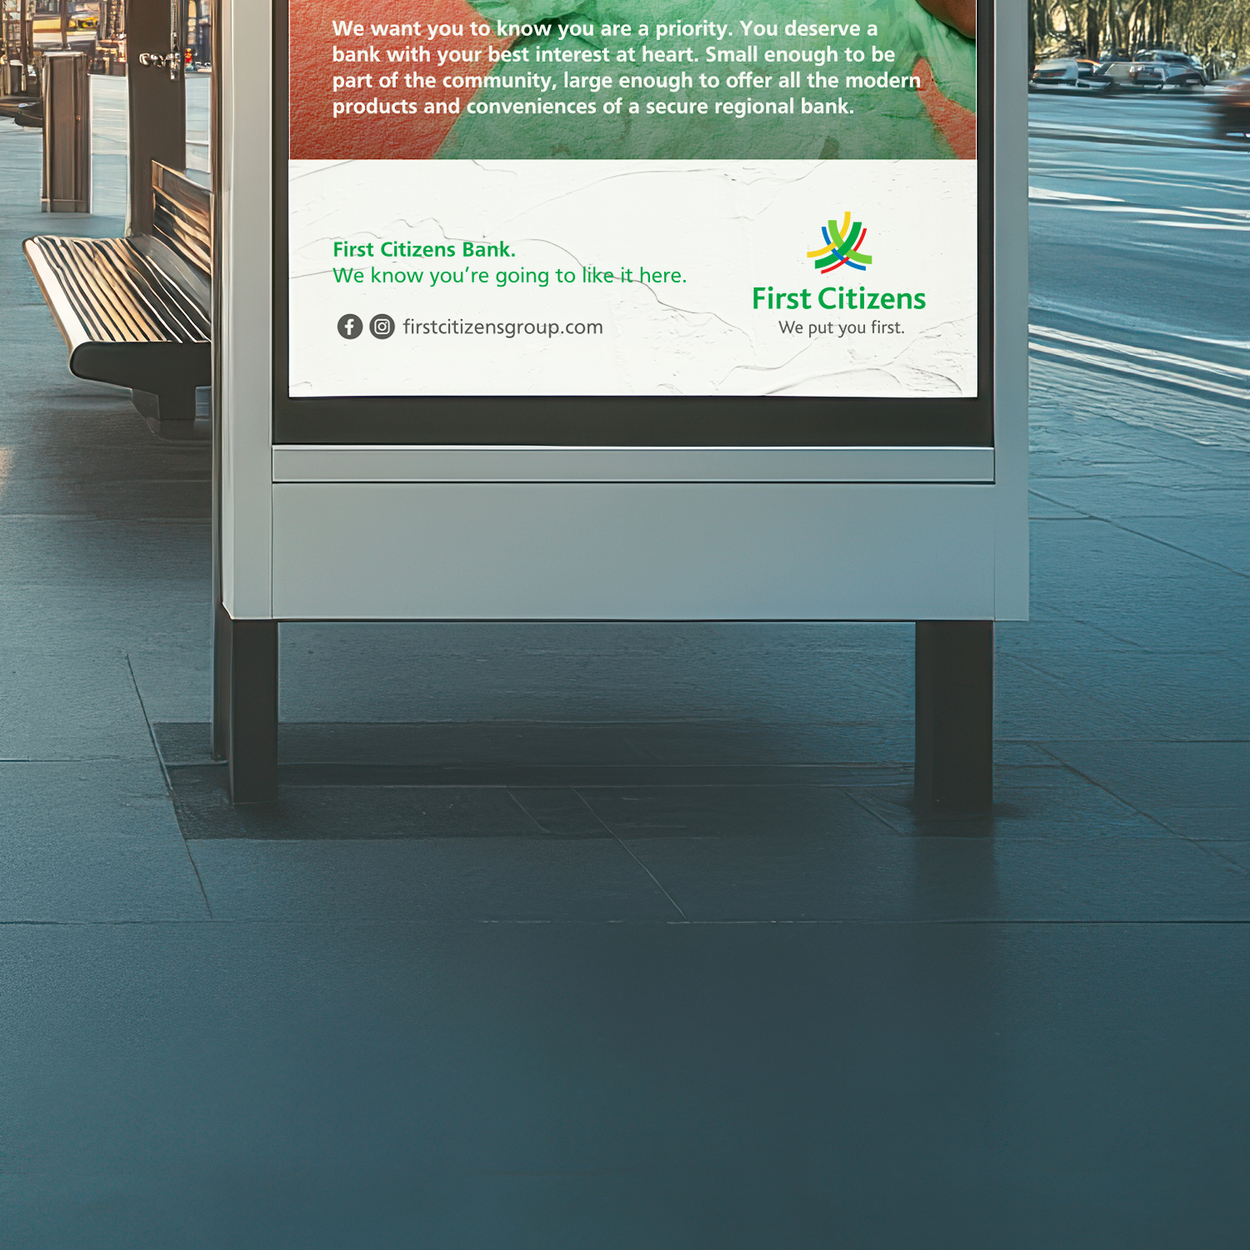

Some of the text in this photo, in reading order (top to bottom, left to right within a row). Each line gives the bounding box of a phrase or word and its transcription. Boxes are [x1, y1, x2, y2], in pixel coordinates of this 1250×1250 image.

[331, 19, 878, 41] We want you to know you are a priority. You deserve a
[332, 45, 896, 67] bank with your best interest at heart. Small enough to be
[333, 70, 921, 93] part of the community, large enough to offer all the modern
[333, 96, 854, 119] products and conveniences of a secure regional bank.
[333, 240, 516, 258] First Citizens Bank.
[332, 266, 687, 288] We know you’re going to like it here.
[753, 285, 927, 310] First Citizens
[402, 318, 603, 339] firstcitizensgroup.com
[778, 319, 905, 339] We put you first.
